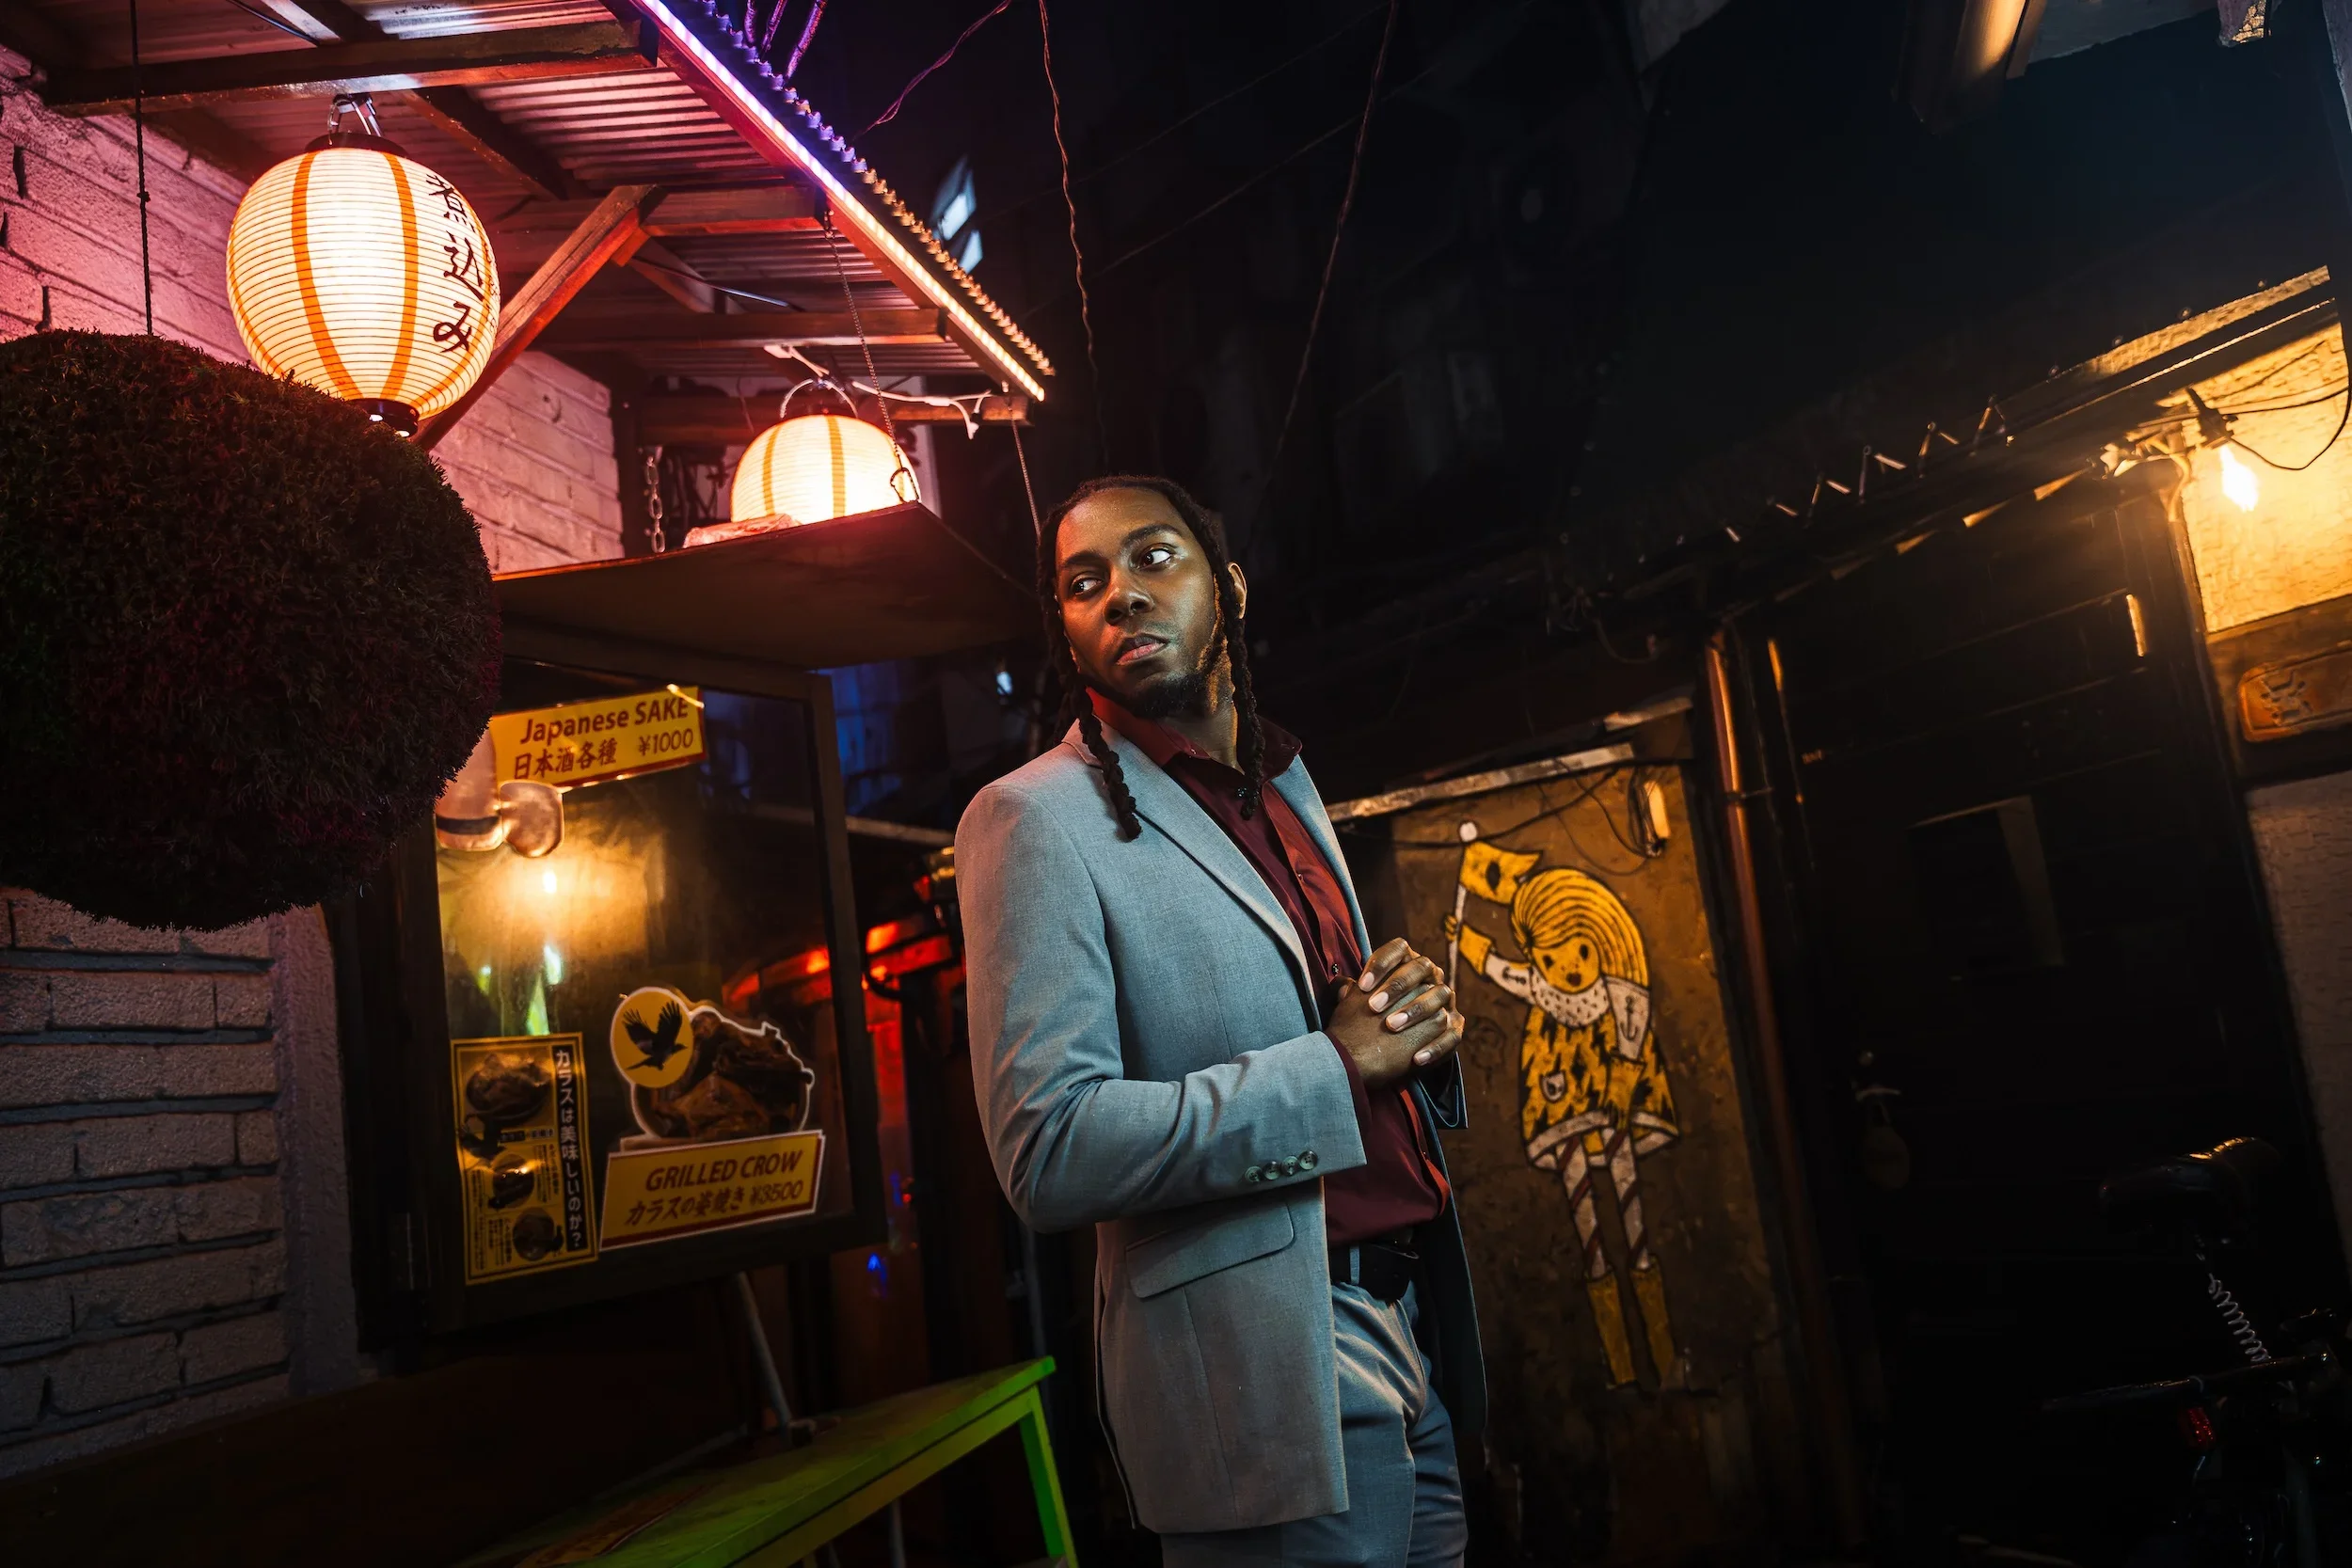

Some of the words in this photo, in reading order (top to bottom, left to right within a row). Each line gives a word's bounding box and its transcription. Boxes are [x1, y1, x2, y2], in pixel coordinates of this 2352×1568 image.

[425, 172, 485, 354] 煮込み
[519, 708, 629, 745] Japanese
[634, 698, 689, 725] SAKE
[514, 738, 618, 780] 日本酒各種
[637, 727, 694, 756] ¥1000
[645, 1158, 738, 1192] GRILLED
[740, 1149, 803, 1179] CROW
[624, 1184, 745, 1227] カラスの姿焼き
[750, 1180, 804, 1207] ¥3500
